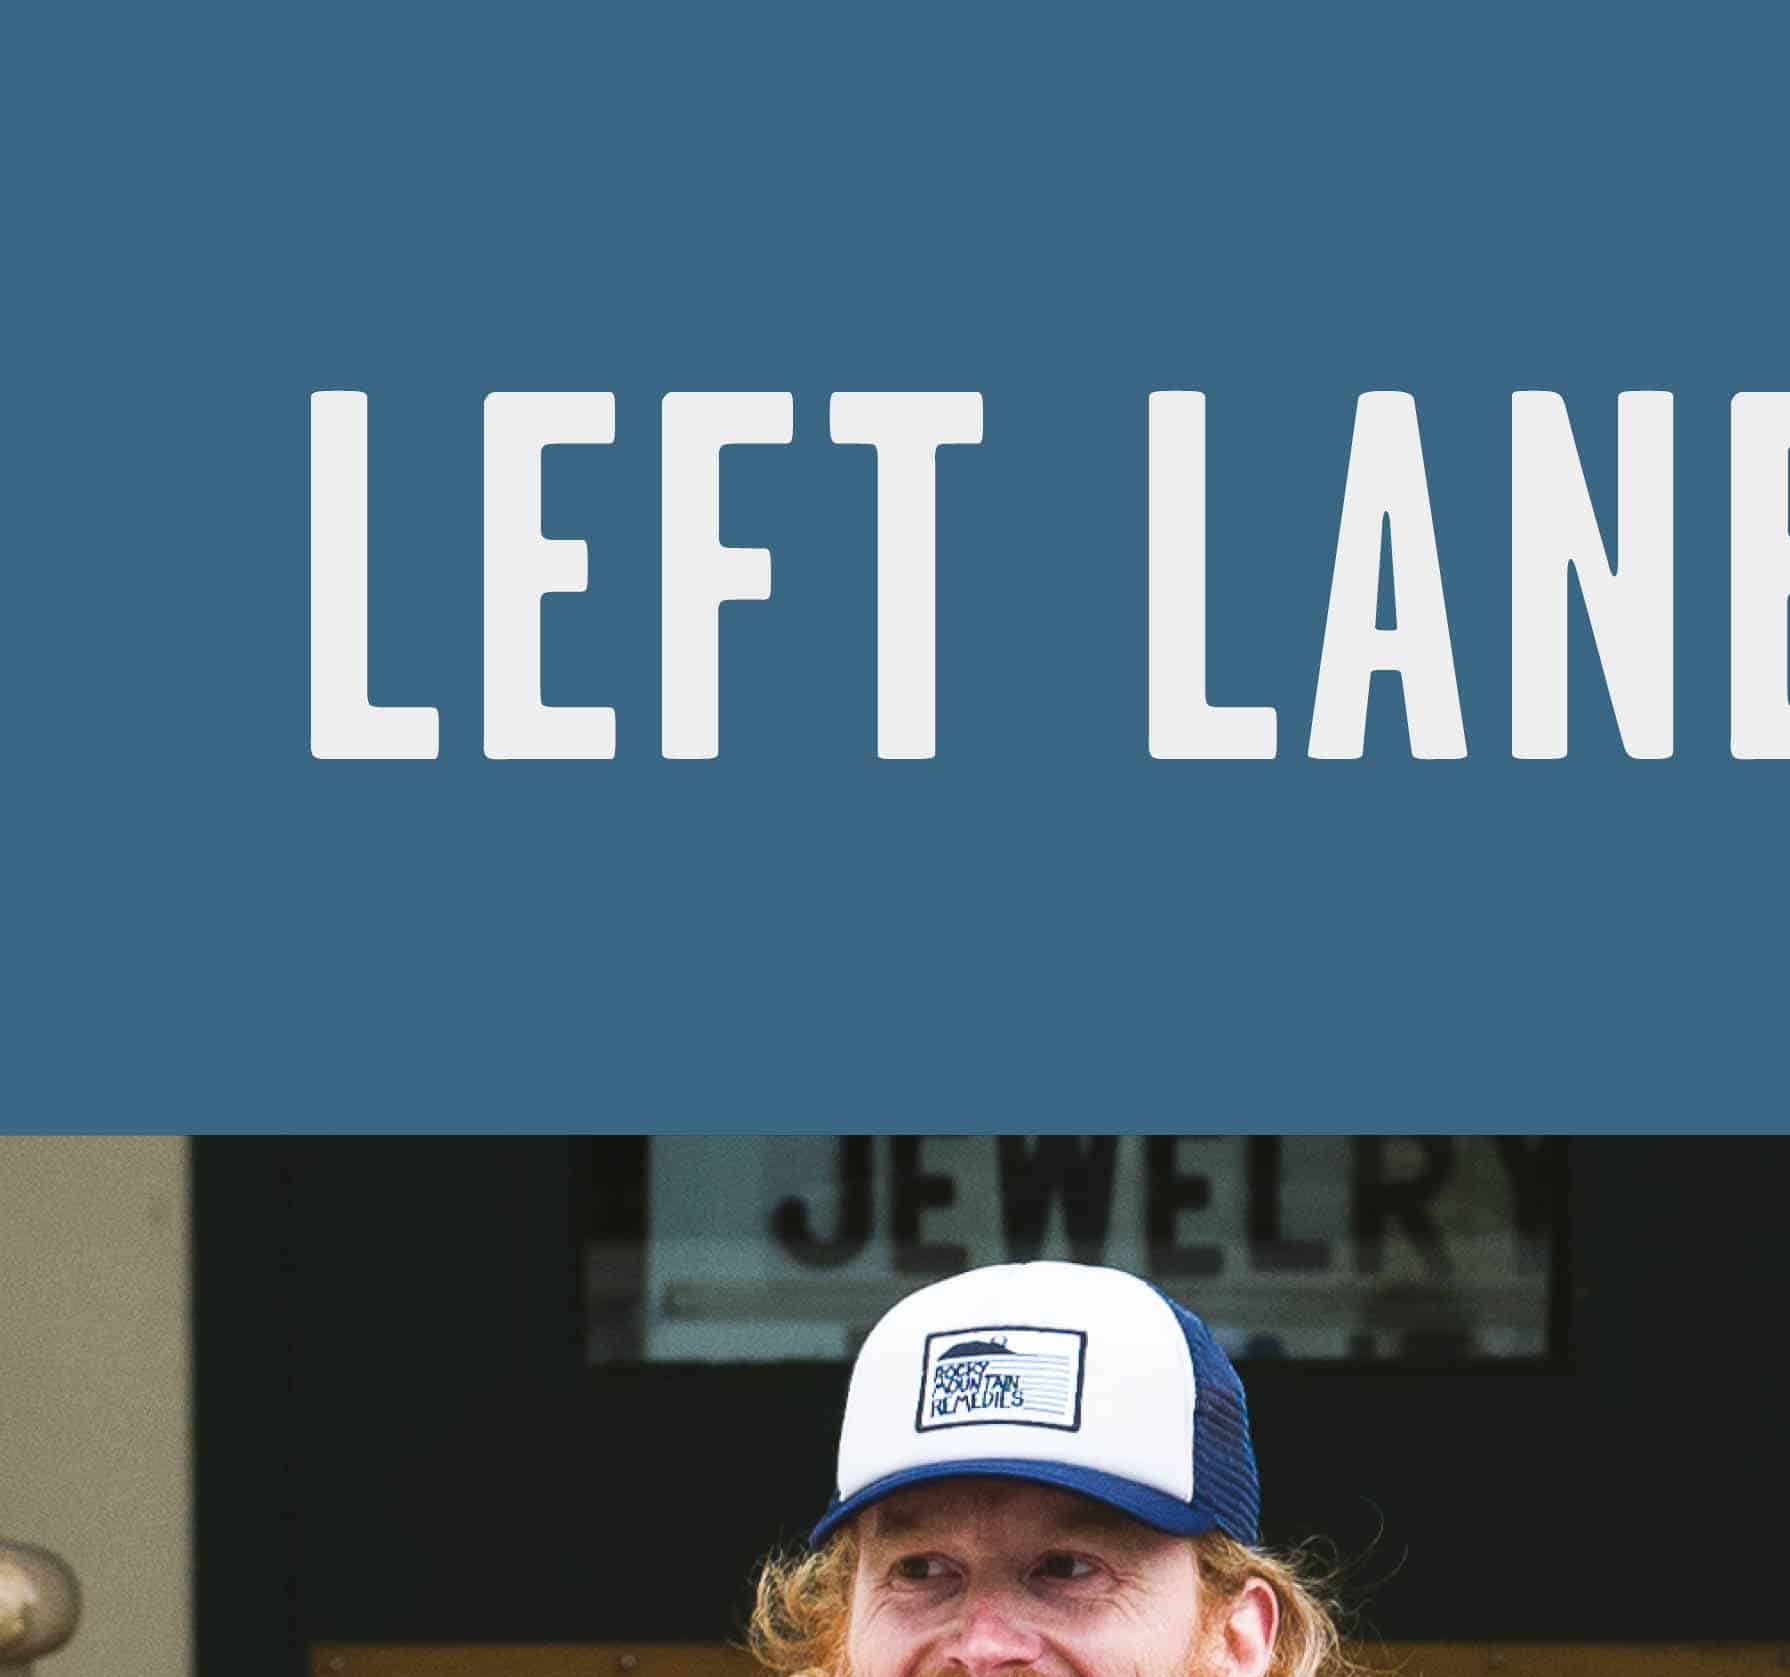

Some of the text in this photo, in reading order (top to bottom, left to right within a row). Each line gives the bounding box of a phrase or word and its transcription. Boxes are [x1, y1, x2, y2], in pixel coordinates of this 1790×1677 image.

[310, 390, 984, 760] LEFT
[934, 1360, 991, 1382] ROCKY
[931, 1373, 1020, 1398] MOUNTAIN
[930, 1390, 1025, 1418] REMEDIES
